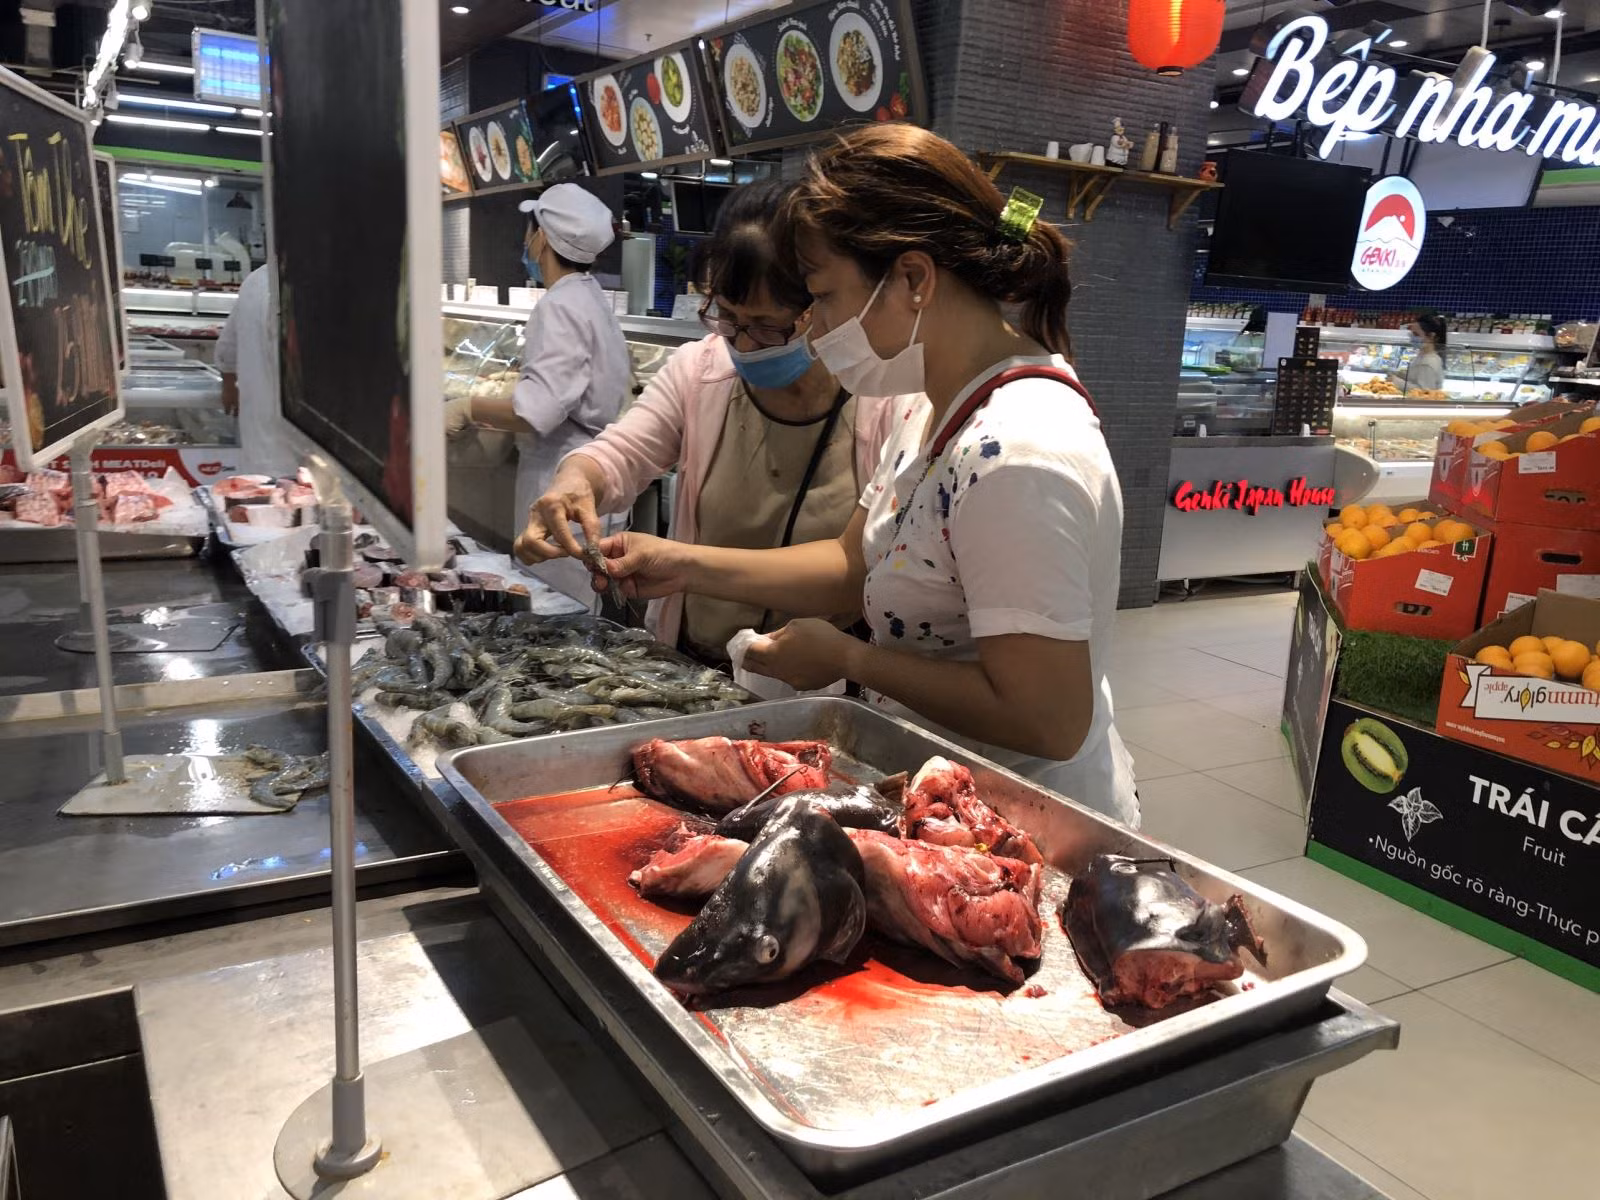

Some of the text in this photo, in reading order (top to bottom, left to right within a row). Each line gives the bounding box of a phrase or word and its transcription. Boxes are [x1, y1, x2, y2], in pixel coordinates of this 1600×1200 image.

[1254, 16, 1397, 159] Bếp
[1360, 246, 1396, 267] GENKI
[1175, 480, 1232, 512] Genki
[1289, 476, 1335, 506] House
[1484, 681, 1508, 694] apple
[1469, 774, 1549, 829] TRÁI
[1523, 836, 1566, 867] Fruit
[1430, 862, 1462, 885] gốc
[1466, 877, 1484, 894] rõ
